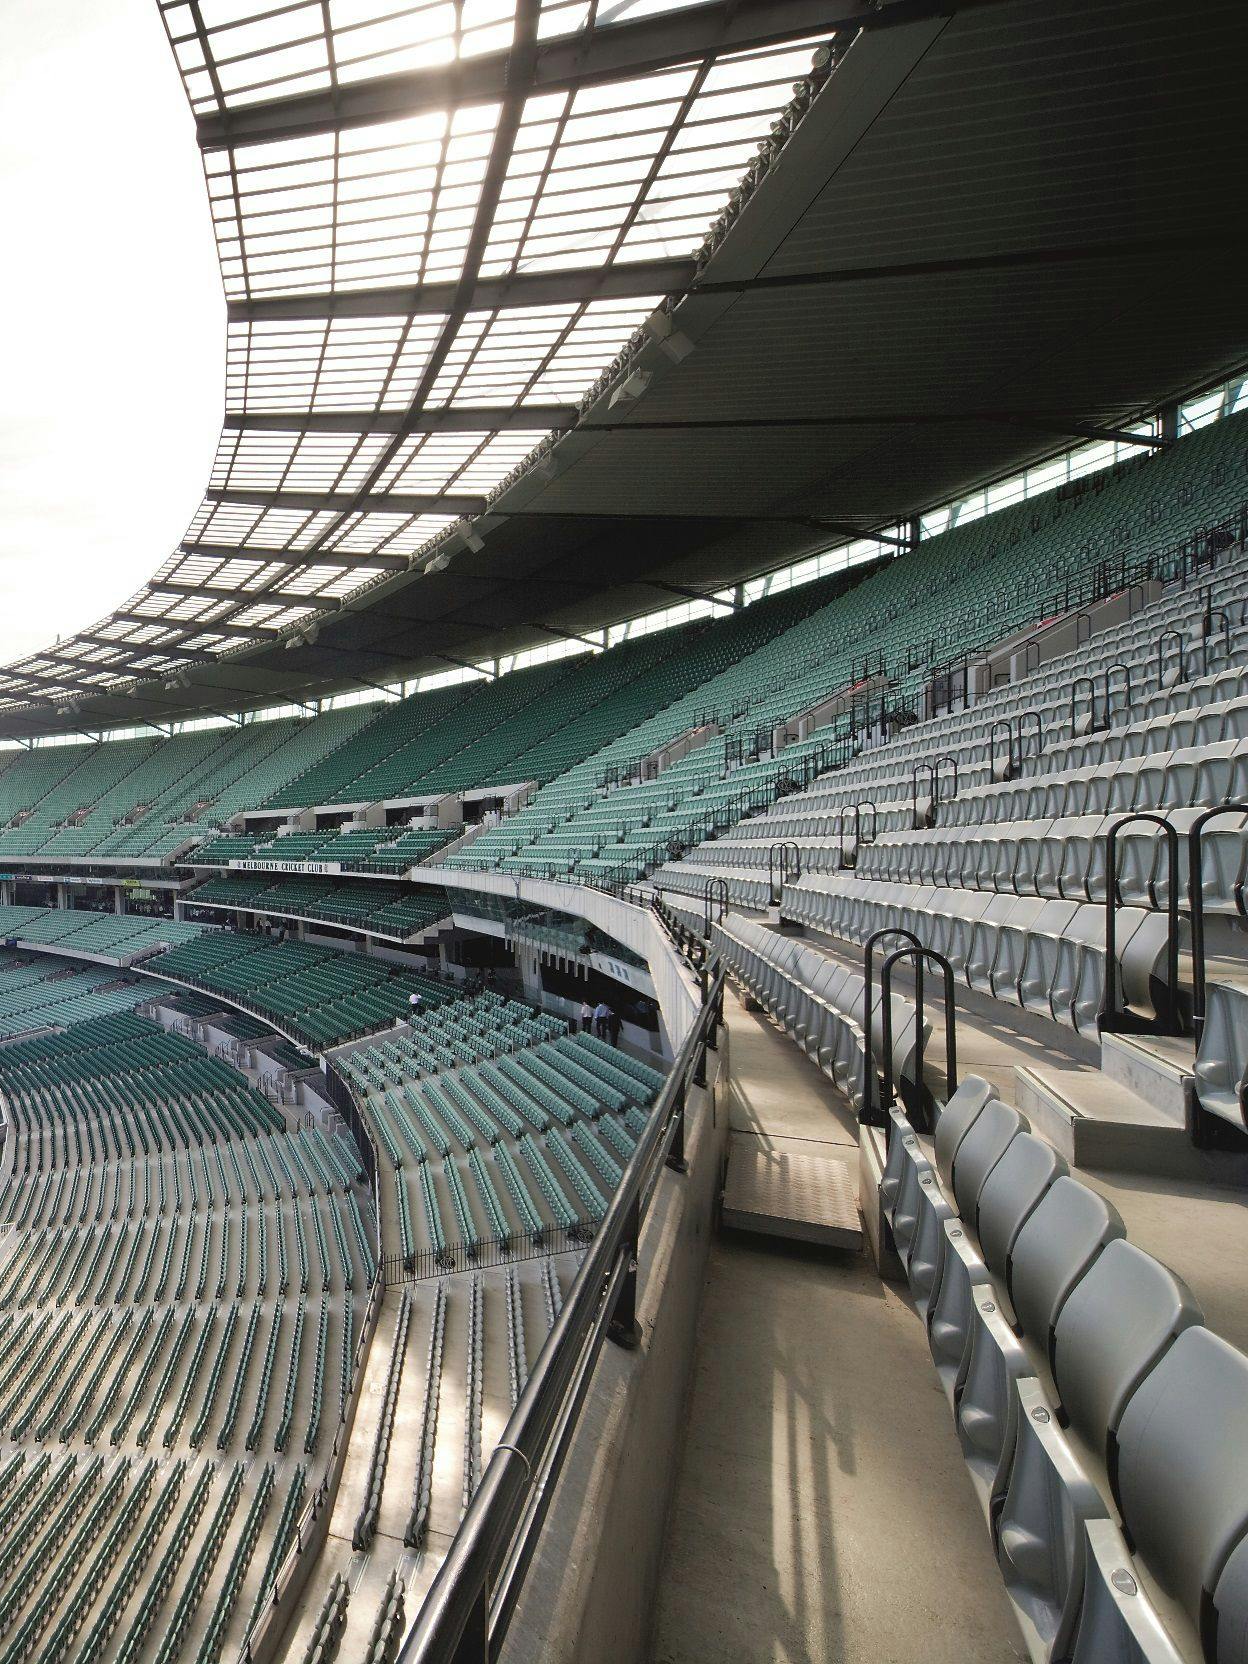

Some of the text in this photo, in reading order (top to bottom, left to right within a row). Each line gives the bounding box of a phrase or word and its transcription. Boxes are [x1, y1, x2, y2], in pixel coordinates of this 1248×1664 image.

[242, 862, 322, 873] MELBOURNE CRICKET CLUB
